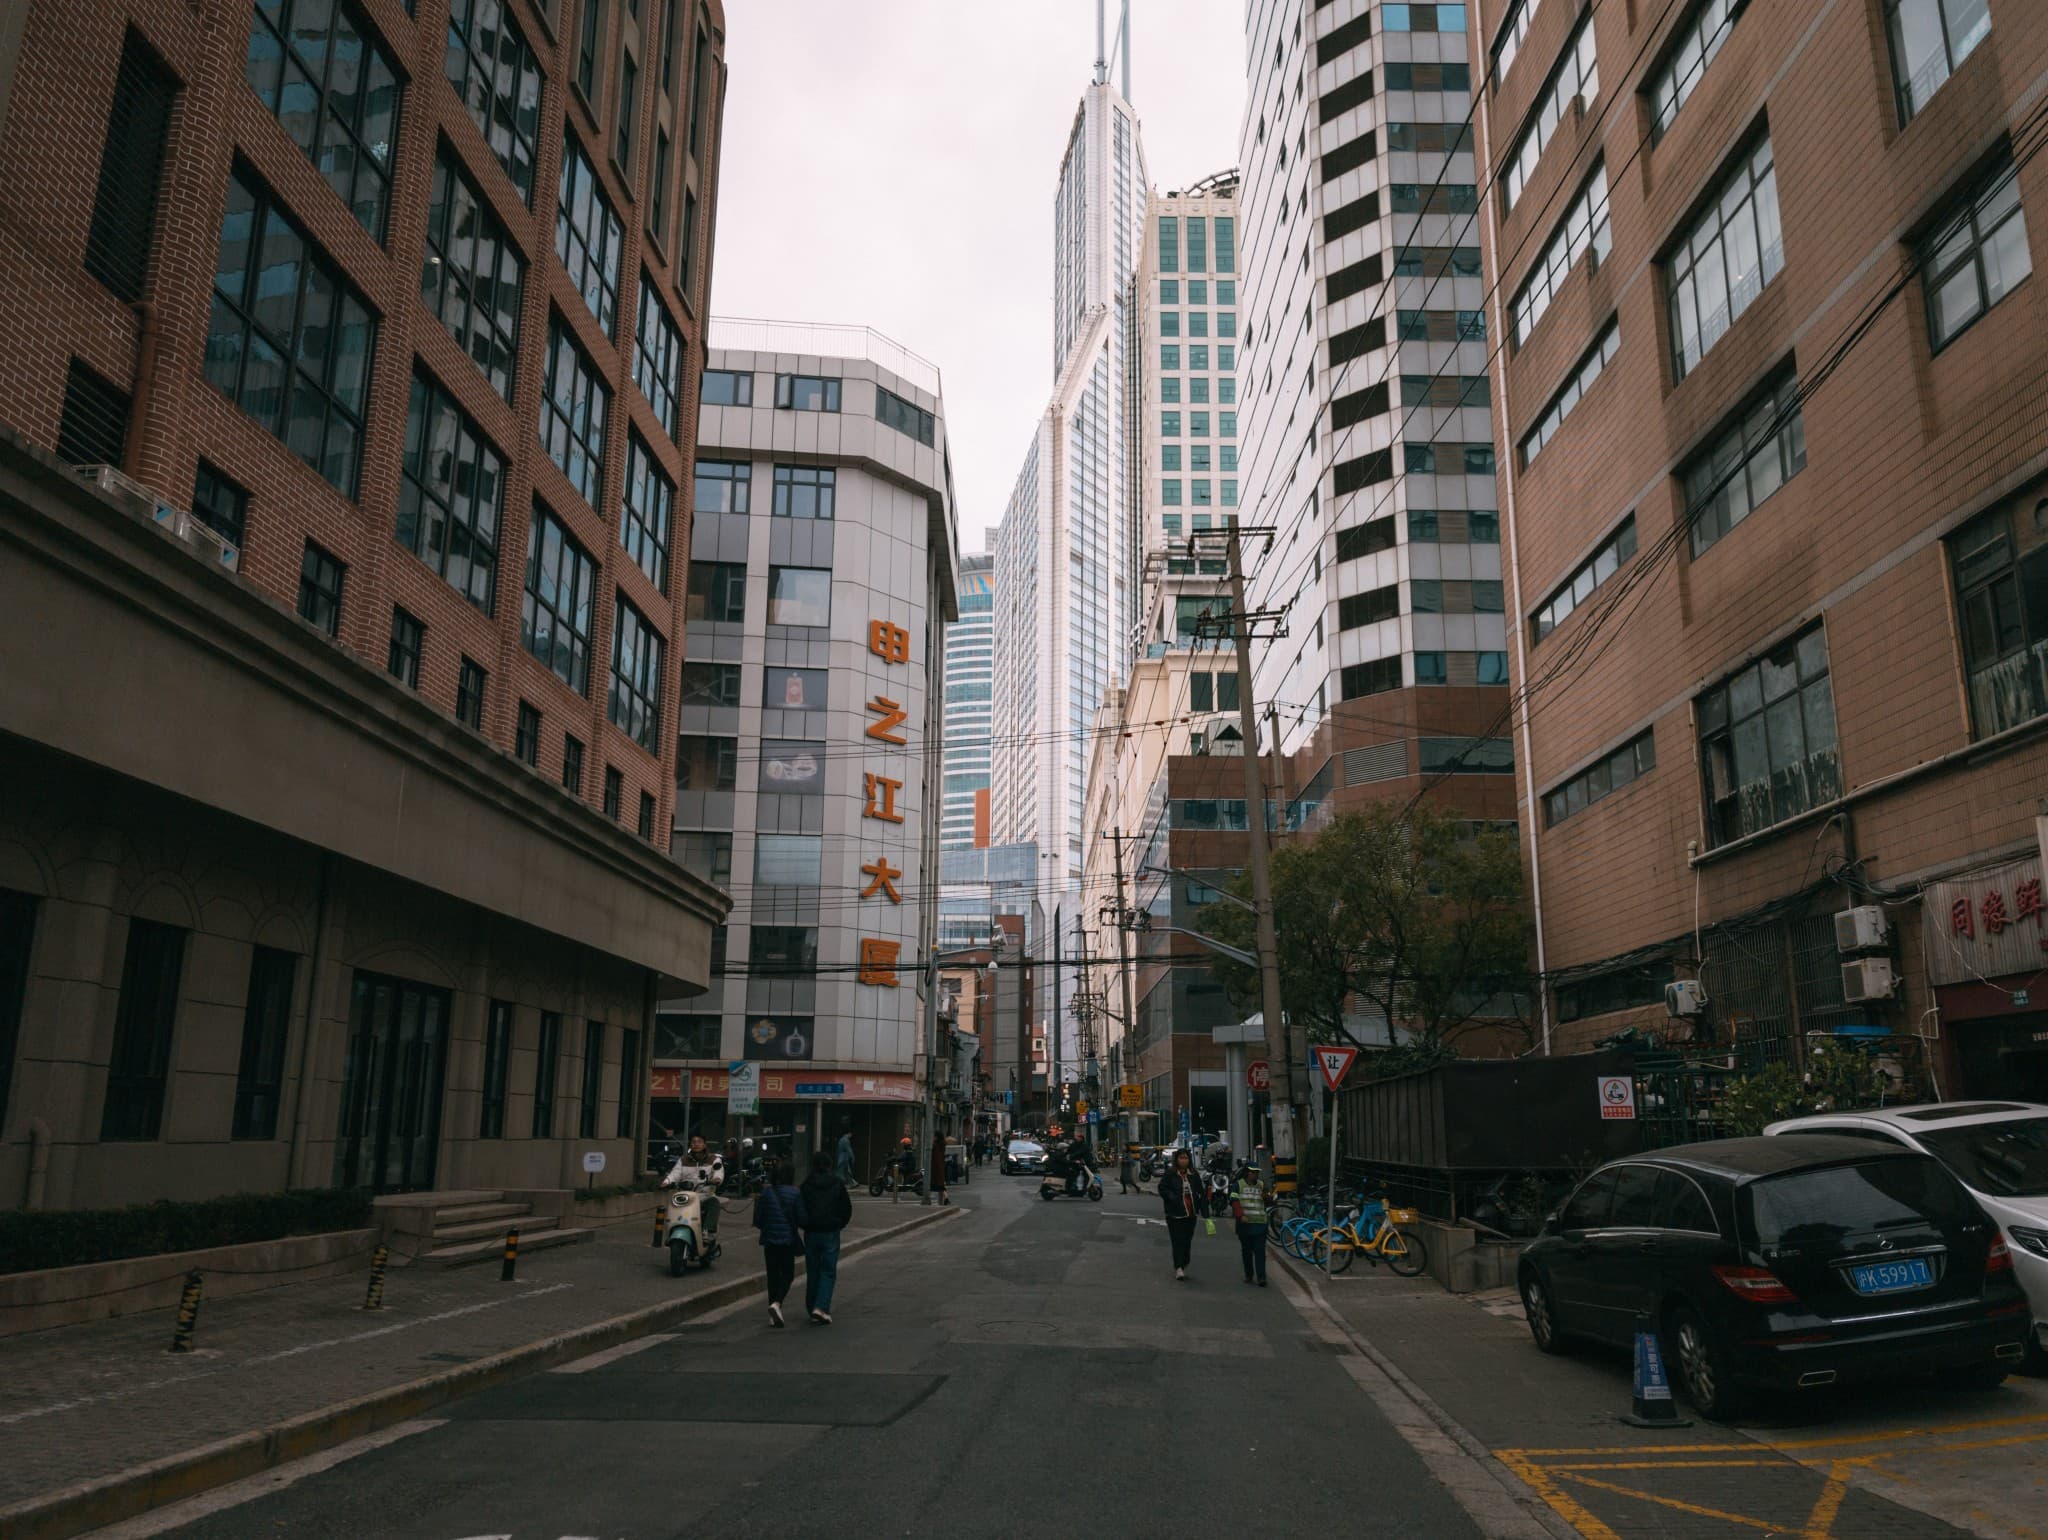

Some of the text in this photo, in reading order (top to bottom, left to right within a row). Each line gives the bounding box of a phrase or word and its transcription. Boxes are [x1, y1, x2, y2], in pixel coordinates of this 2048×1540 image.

[860, 619, 909, 986] 申之江大厦
[1327, 1056, 1340, 1069] 让
[1251, 1066, 1270, 1087] 停
